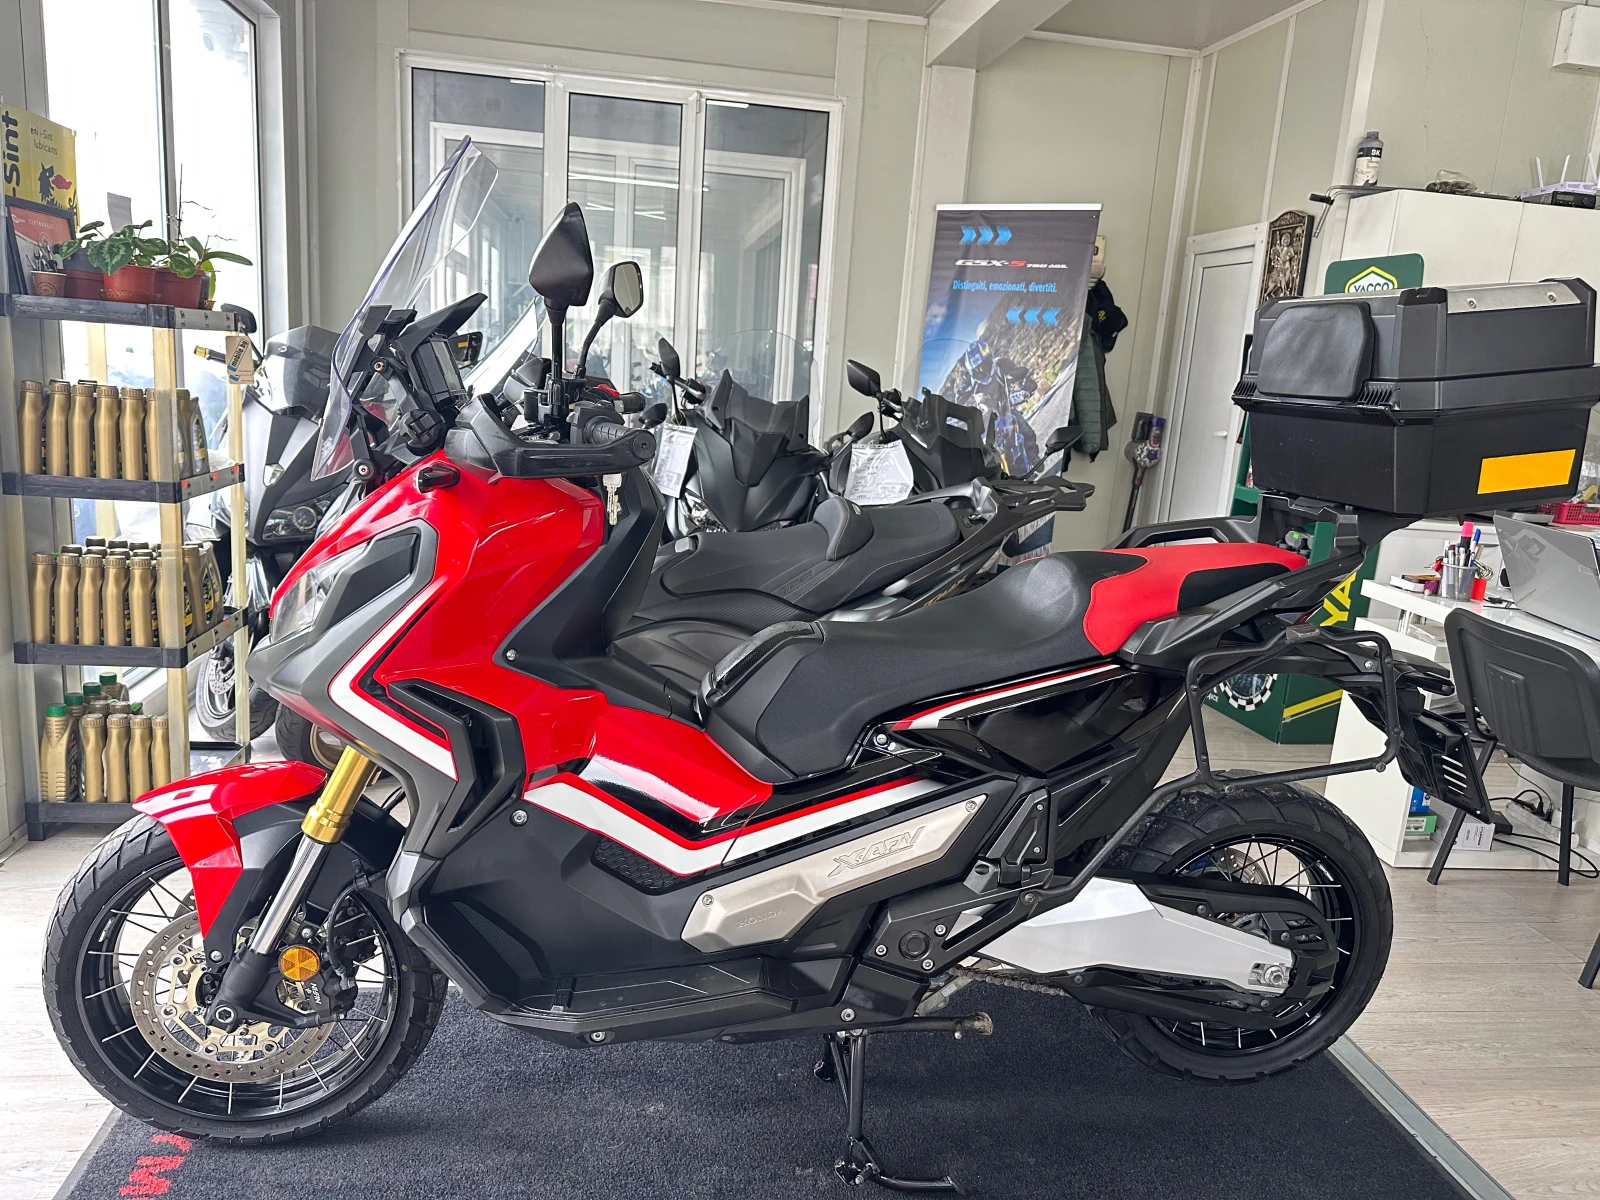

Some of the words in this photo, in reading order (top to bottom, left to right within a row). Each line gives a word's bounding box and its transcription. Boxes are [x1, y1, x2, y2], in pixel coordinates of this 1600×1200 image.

[30, 126, 39, 137] eni
[39, 128, 53, 141] i-Sint
[2, 110, 20, 197] -Sint
[33, 139, 58, 155] lubricants
[955, 259, 1027, 267] GSX-S
[953, 279, 987, 292] Distinguiti,
[989, 281, 1026, 293] emozionati,
[1028, 282, 1057, 293] divertiti.
[231, 340, 248, 367] mobile.bg
[1320, 571, 1357, 627] YA
[737, 907, 787, 928] HONDA
[310, 982, 322, 1005] NISSIN
